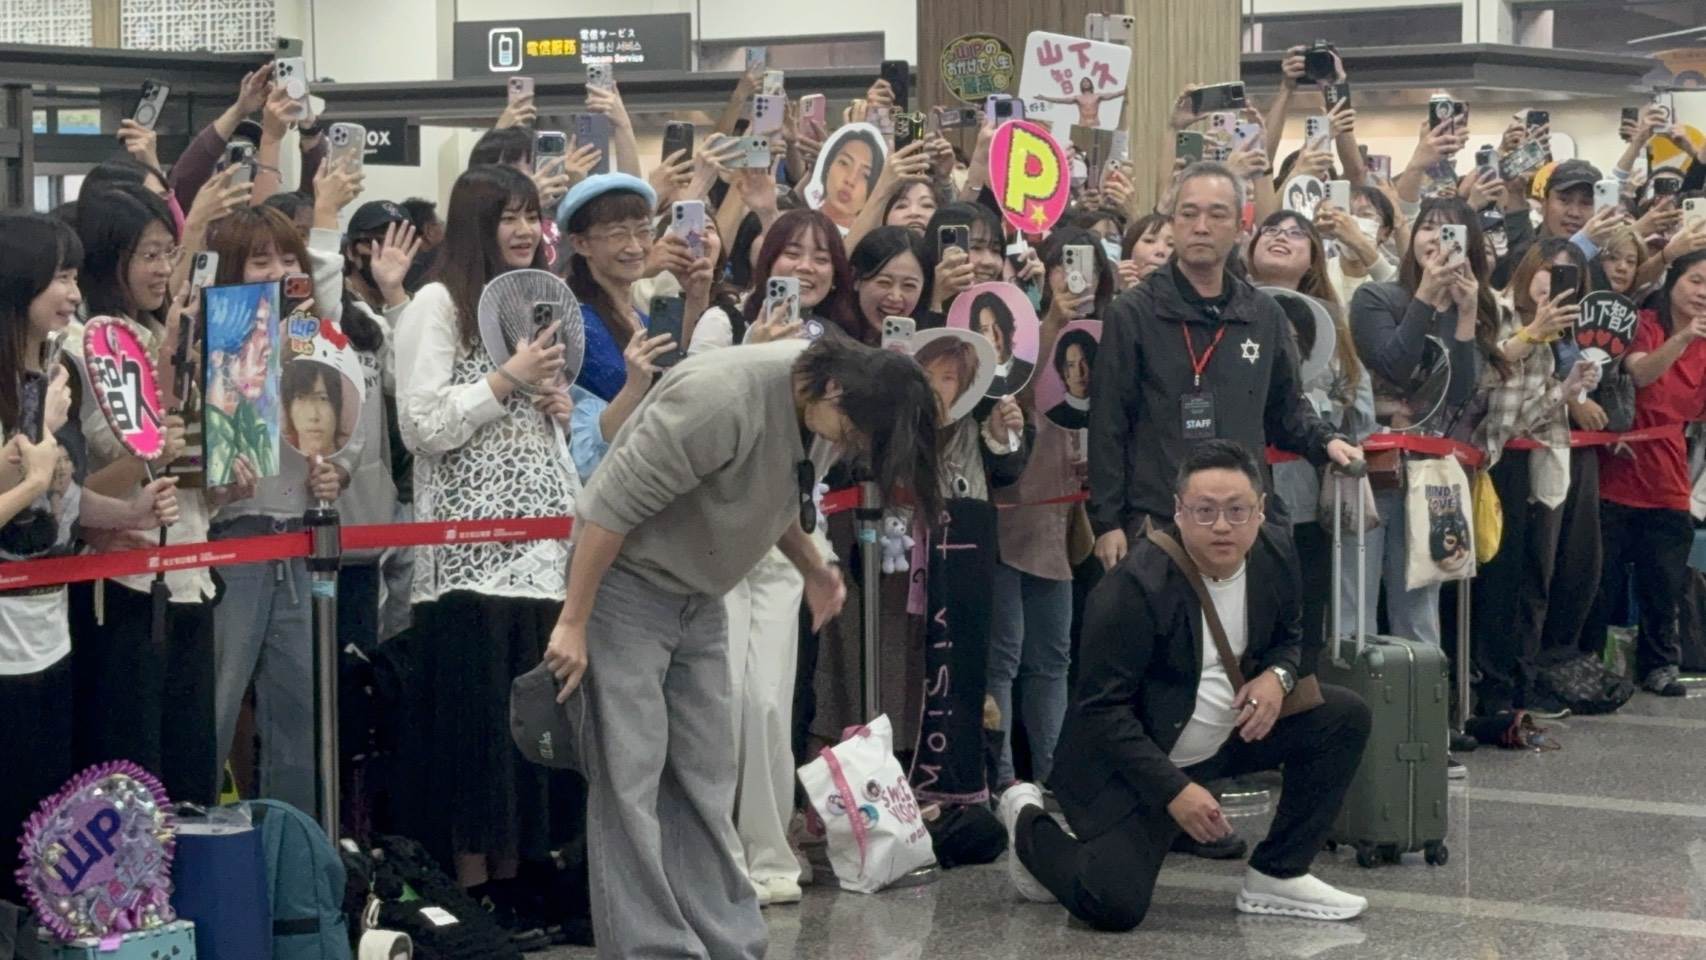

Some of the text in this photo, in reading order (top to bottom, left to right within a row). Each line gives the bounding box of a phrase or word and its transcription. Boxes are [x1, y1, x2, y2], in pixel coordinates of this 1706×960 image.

[526, 39, 577, 57] 電信服務
[1004, 127, 1059, 215] P
[1579, 300, 1637, 340] 山下智久
[1186, 419, 1211, 429] STAFF
